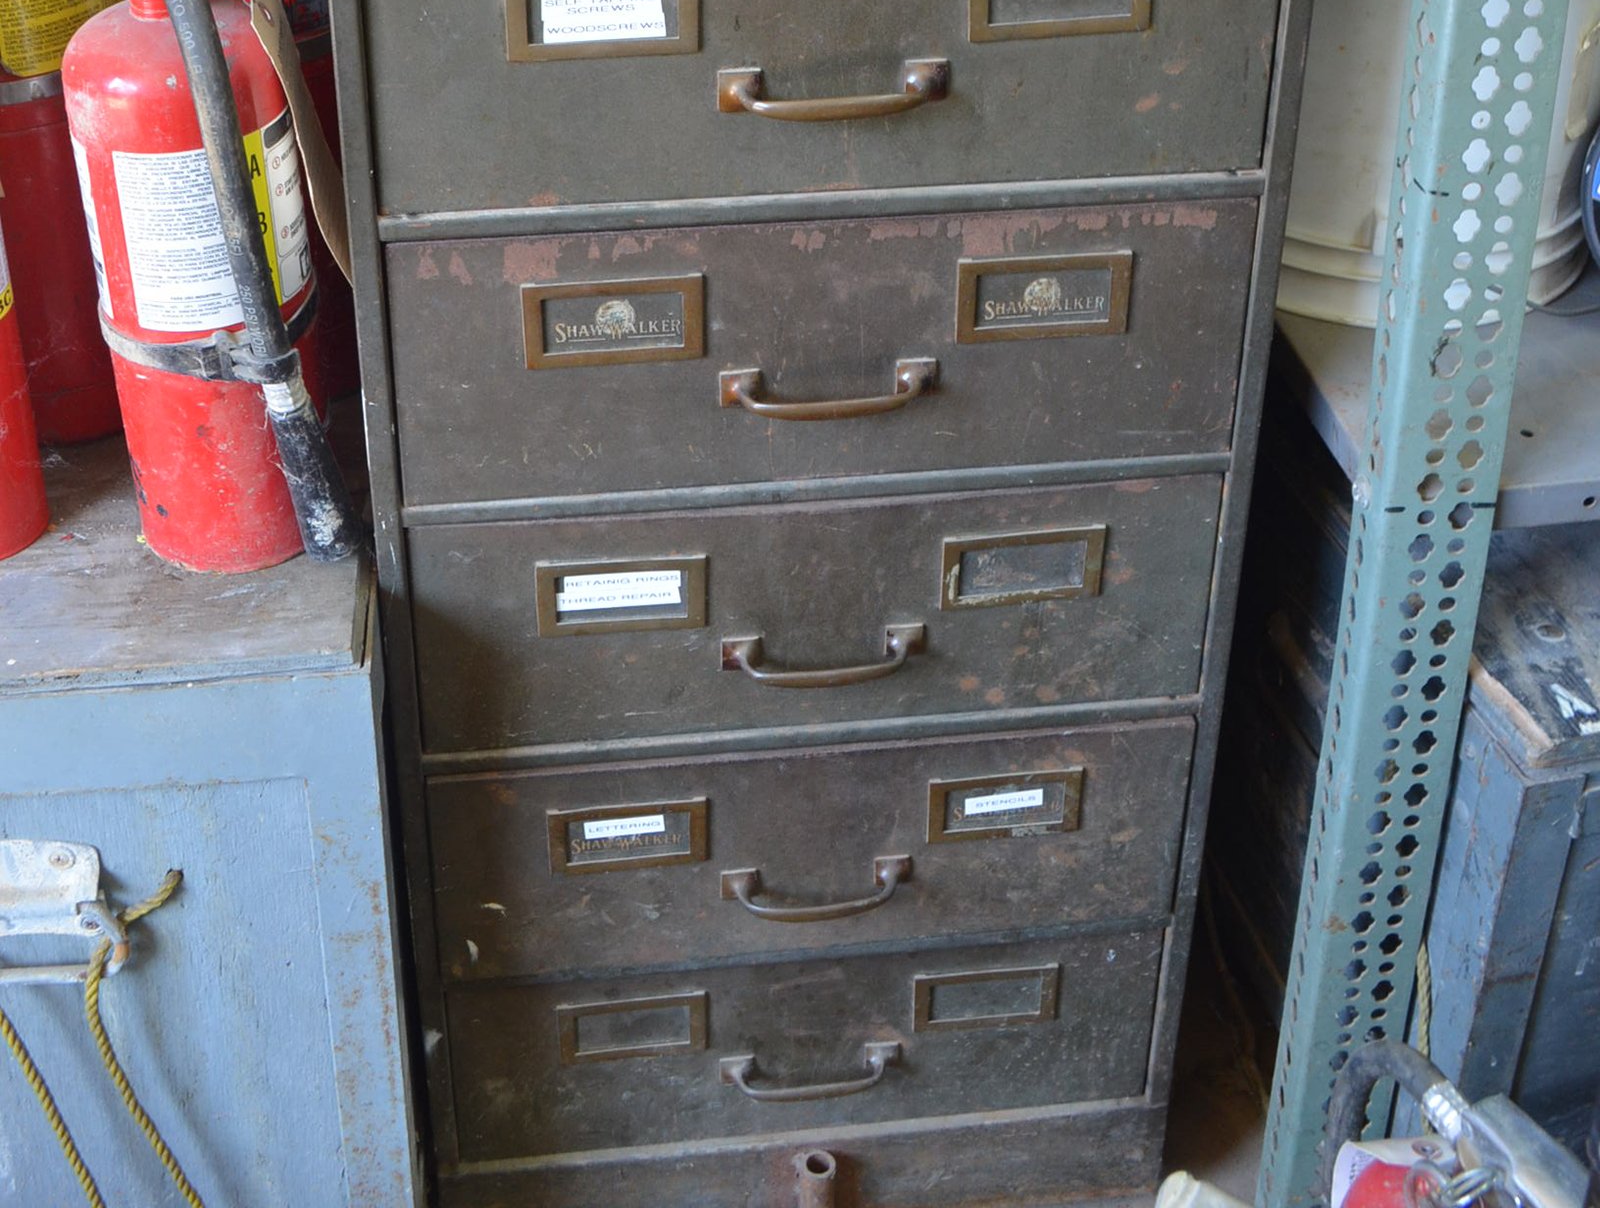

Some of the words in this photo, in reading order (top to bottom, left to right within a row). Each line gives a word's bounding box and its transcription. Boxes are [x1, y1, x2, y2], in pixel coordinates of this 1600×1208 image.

[544, 0, 582, 8] SELF
[567, 3, 635, 15] SCREWS
[547, 21, 664, 34] WOODSCREWS
[178, 22, 196, 51] 500
[238, 284, 252, 309] 250
[245, 307, 258, 328] PSI
[636, 574, 679, 583] RINGS
[560, 595, 616, 605] THREAD
[621, 592, 671, 601] REPAIR
[975, 795, 1037, 808] STENCILS
[588, 821, 661, 834] LETTERING
